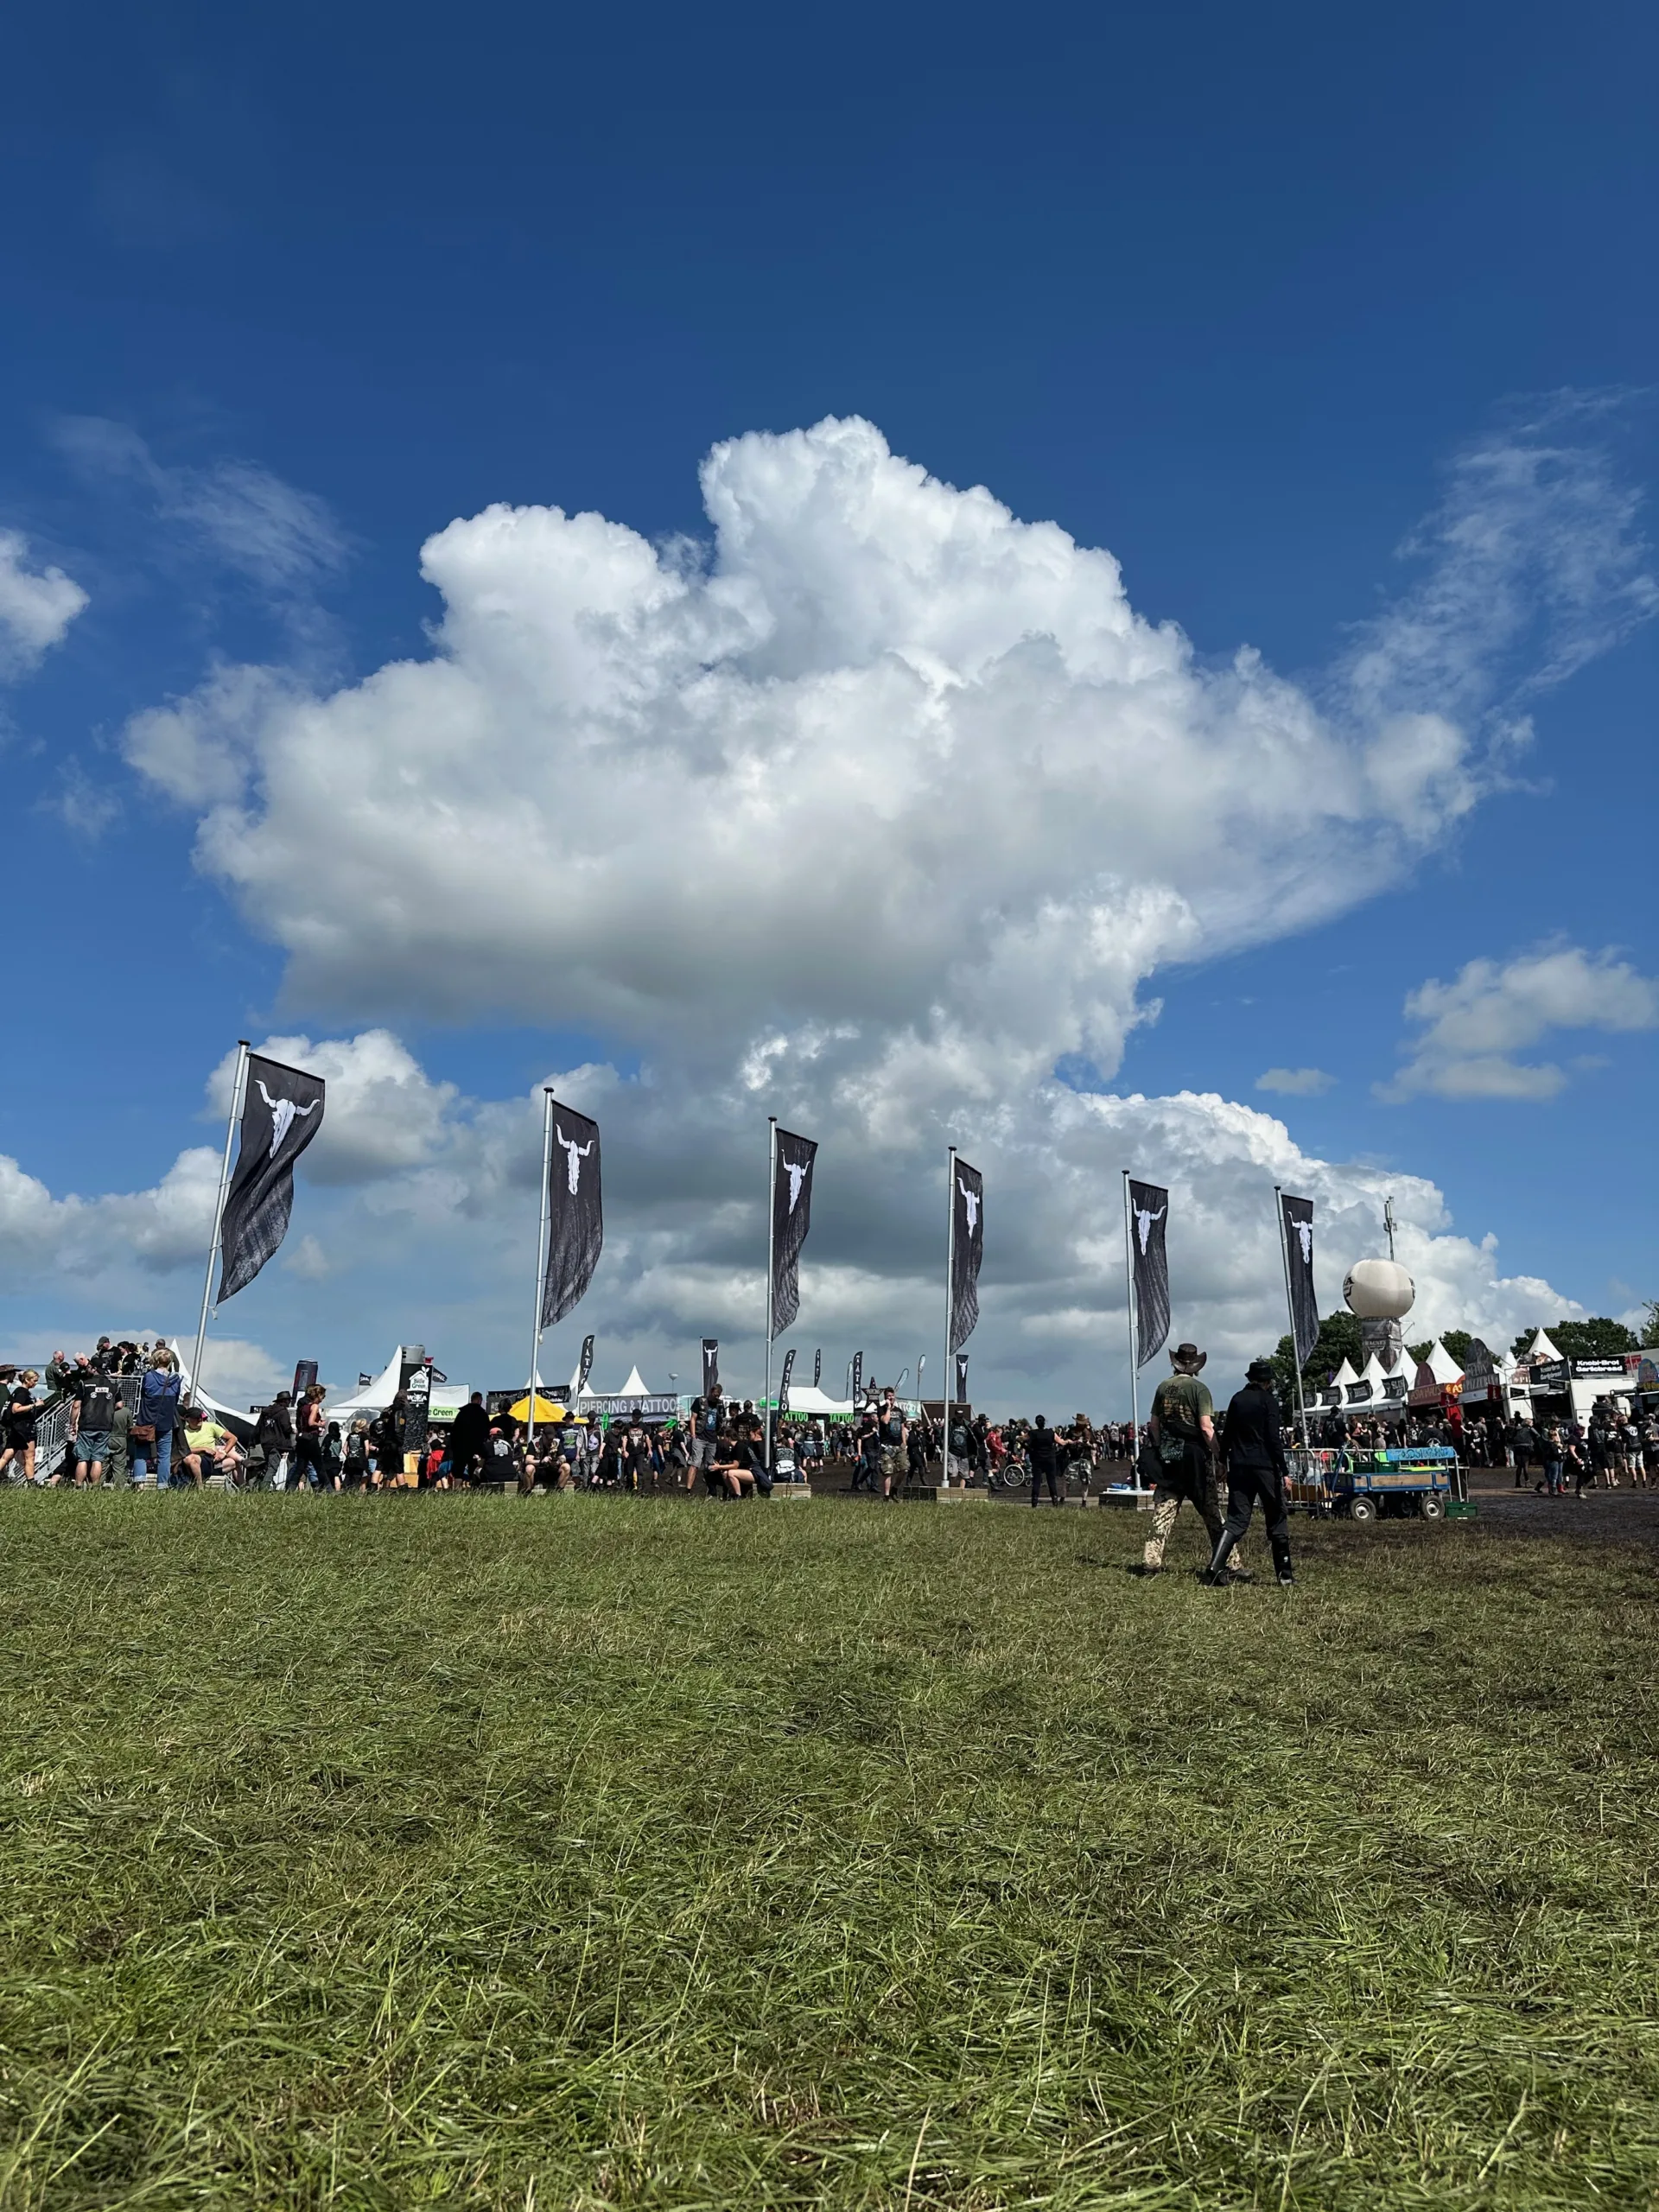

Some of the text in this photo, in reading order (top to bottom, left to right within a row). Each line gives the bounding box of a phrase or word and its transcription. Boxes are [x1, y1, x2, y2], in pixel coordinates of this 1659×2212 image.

[580, 1400, 627, 1414] PIERCING
[639, 1398, 677, 1413] TATTOO
[830, 1414, 855, 1422] TATTOO
